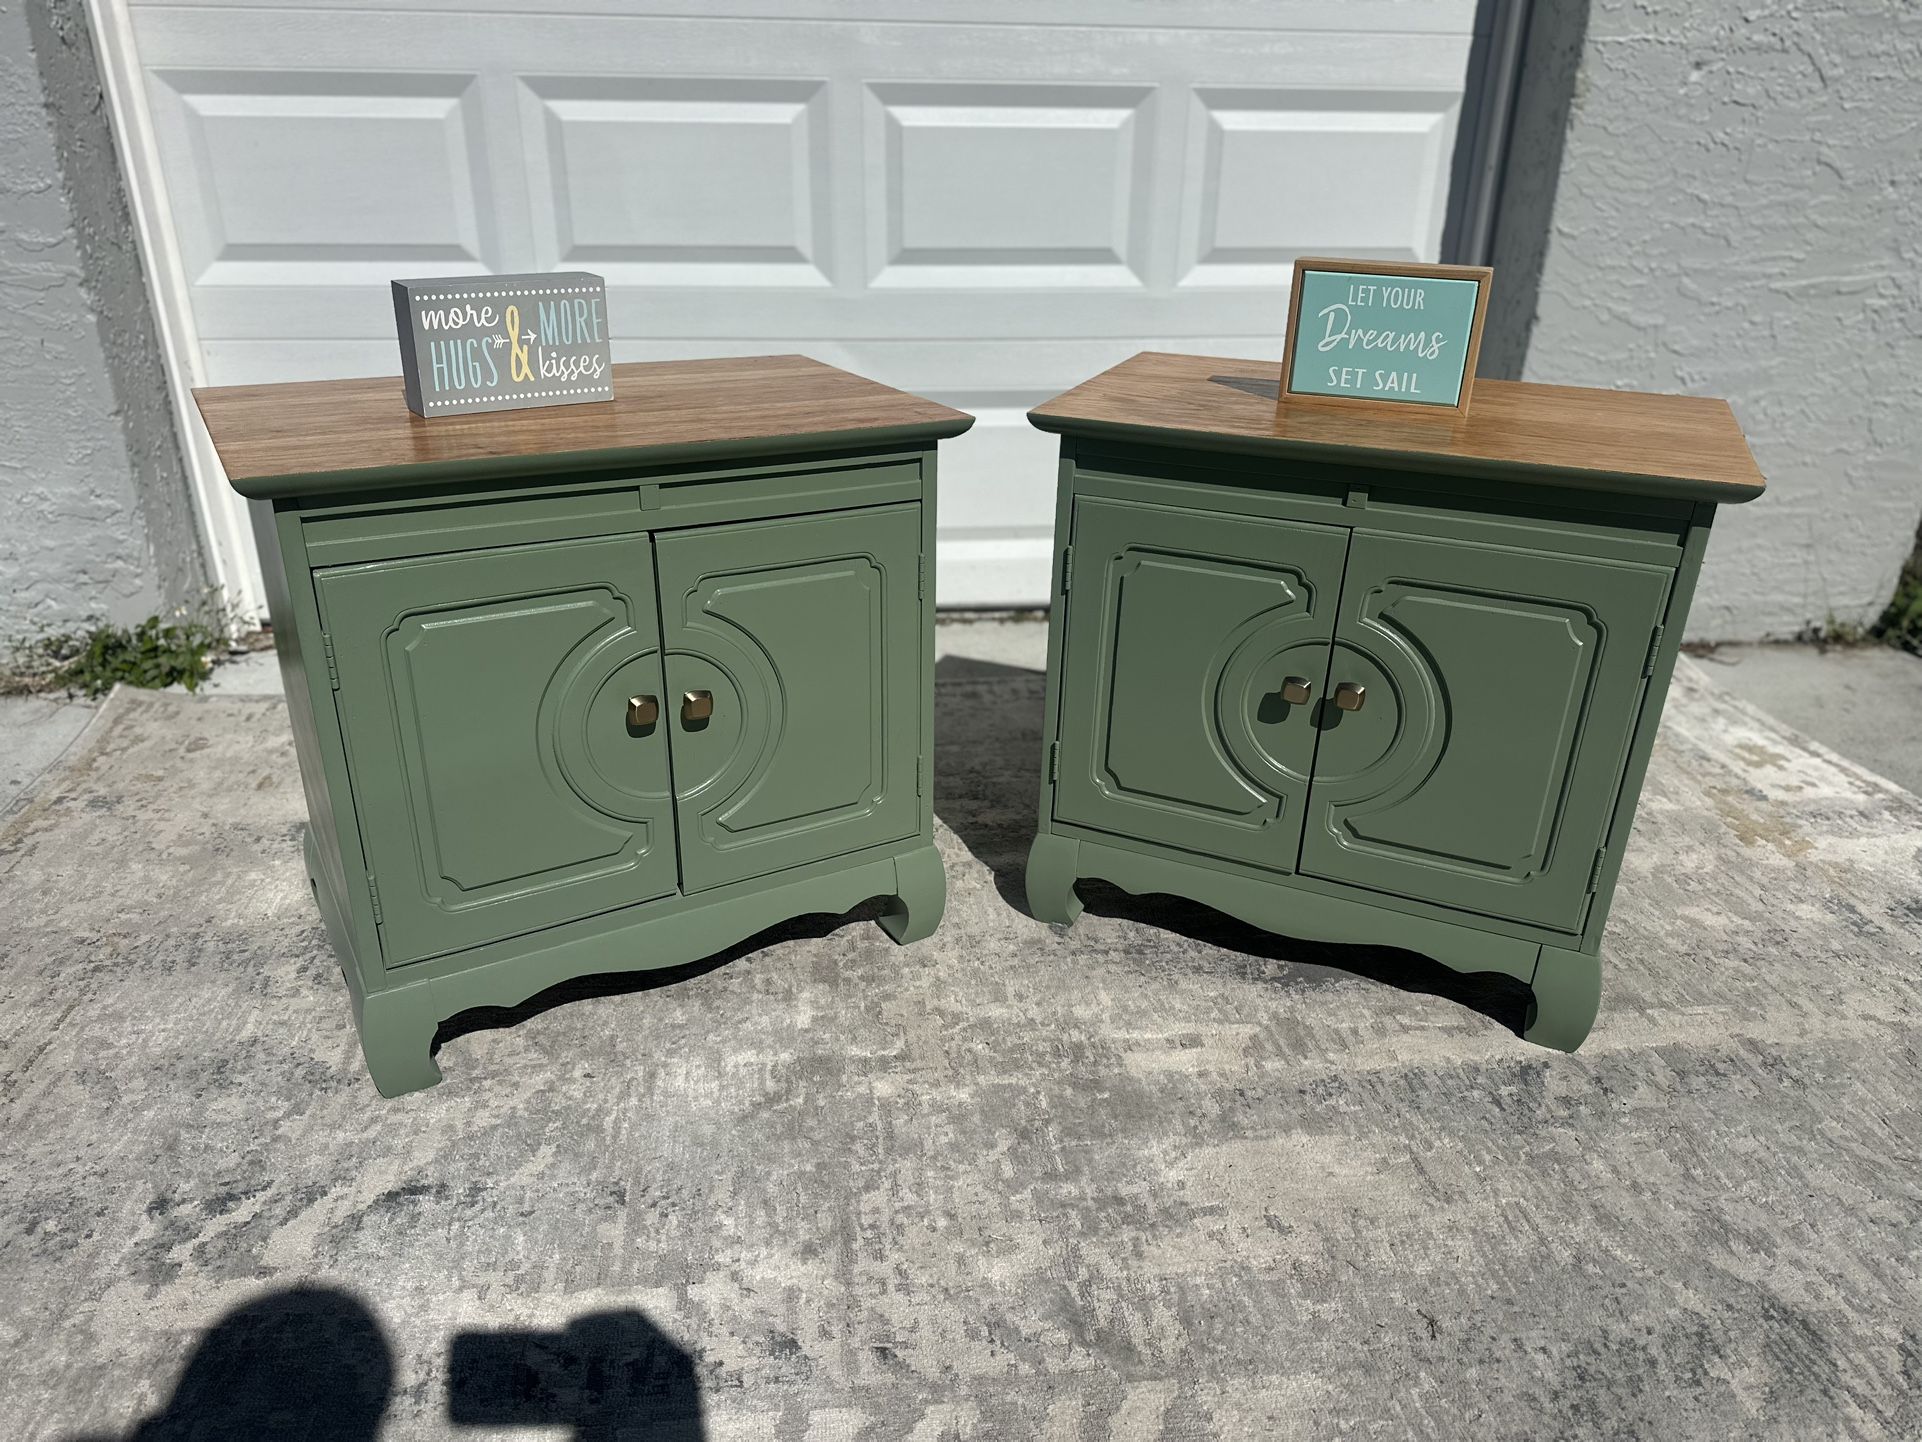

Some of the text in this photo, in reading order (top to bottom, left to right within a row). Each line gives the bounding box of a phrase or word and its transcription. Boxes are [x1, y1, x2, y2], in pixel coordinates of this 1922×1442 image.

[421, 304, 499, 330] more
[1348, 284, 1425, 310] LET YOUR
[538, 299, 603, 346] MORE
[1317, 303, 1448, 360] Dreams
[430, 336, 499, 392] HUGS
[505, 305, 535, 383] &
[538, 345, 605, 382] kisses
[1327, 366, 1421, 394] SET SAIL
